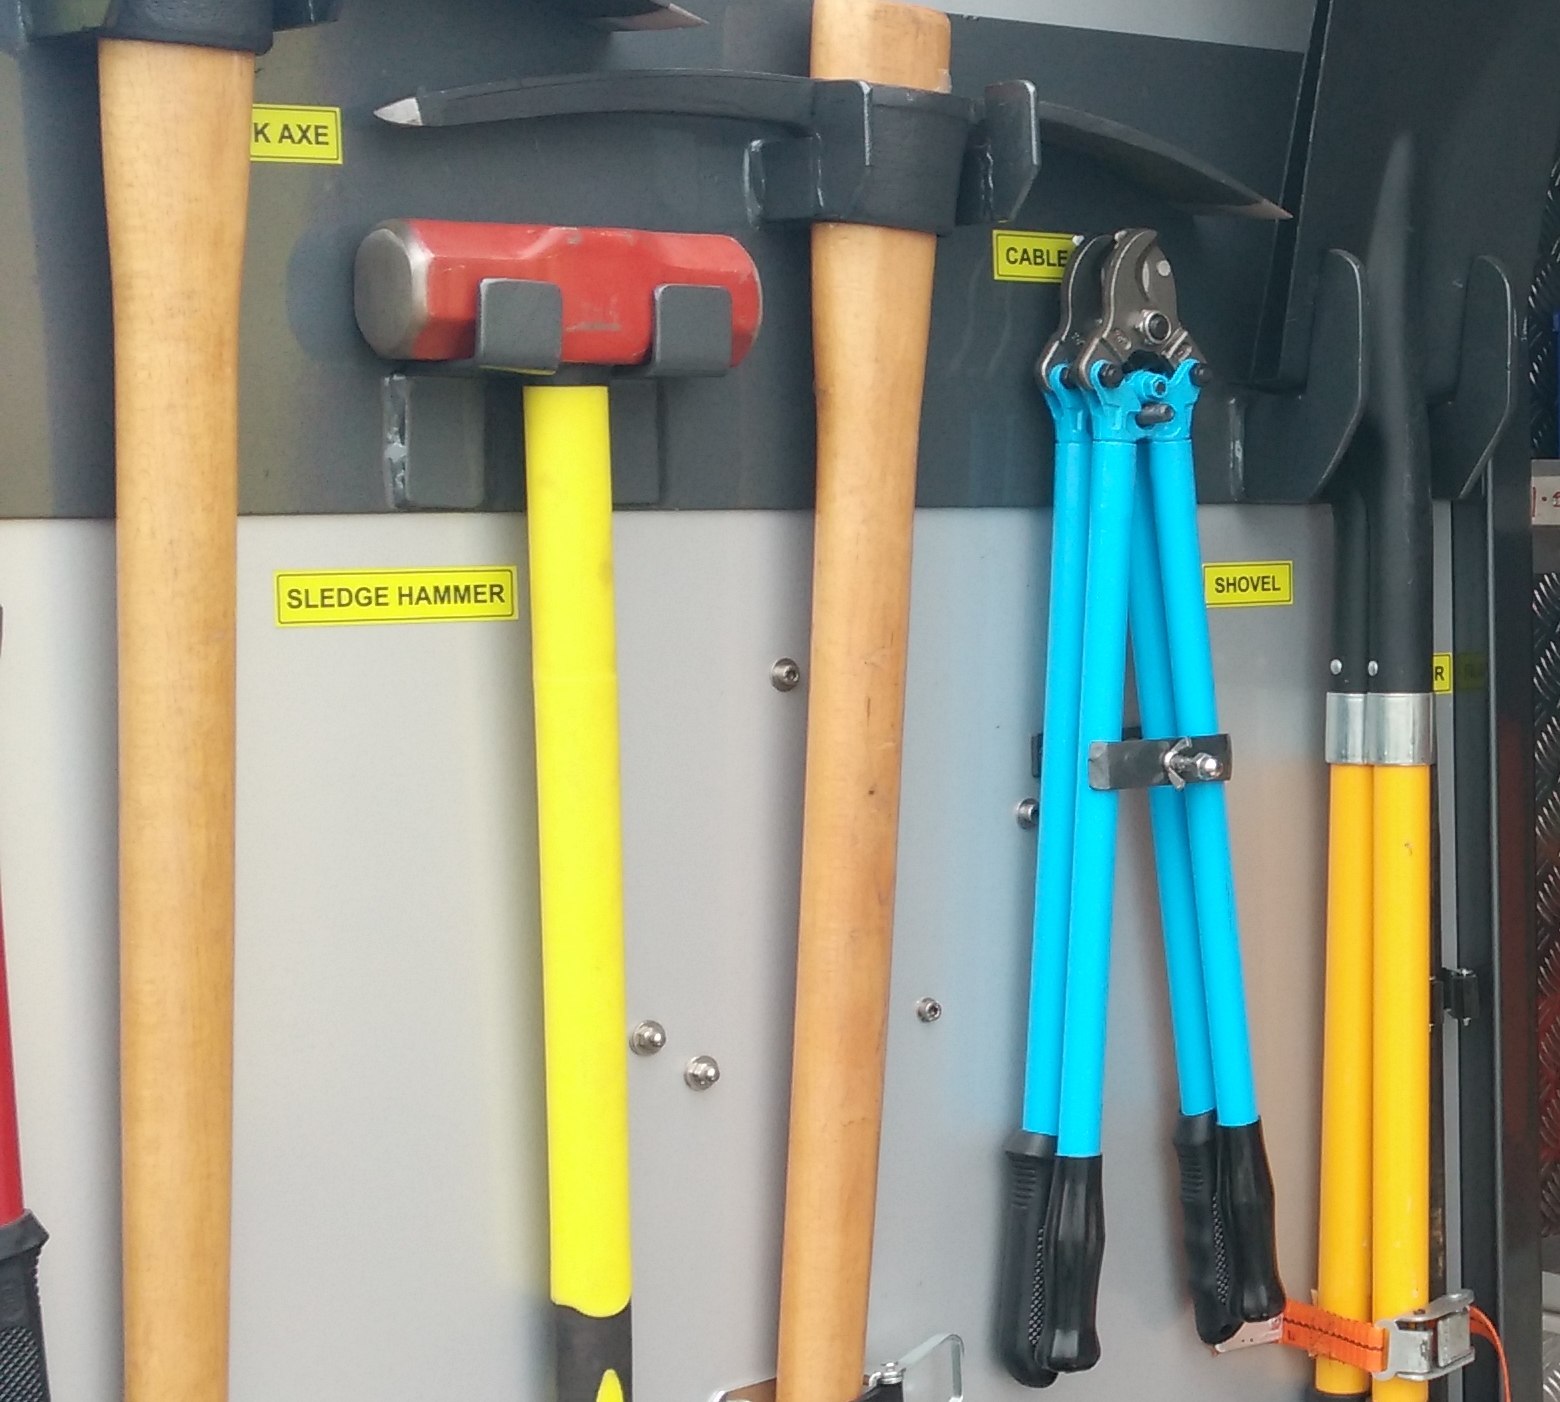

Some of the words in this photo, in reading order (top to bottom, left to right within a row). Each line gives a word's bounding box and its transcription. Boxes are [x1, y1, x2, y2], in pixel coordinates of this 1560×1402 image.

[277, 123, 329, 146] AXE
[1005, 246, 1068, 268] CABLE
[1214, 574, 1282, 594] SHOVEL
[286, 586, 390, 610] SLEDGE
[397, 583, 506, 607] HAMMER
